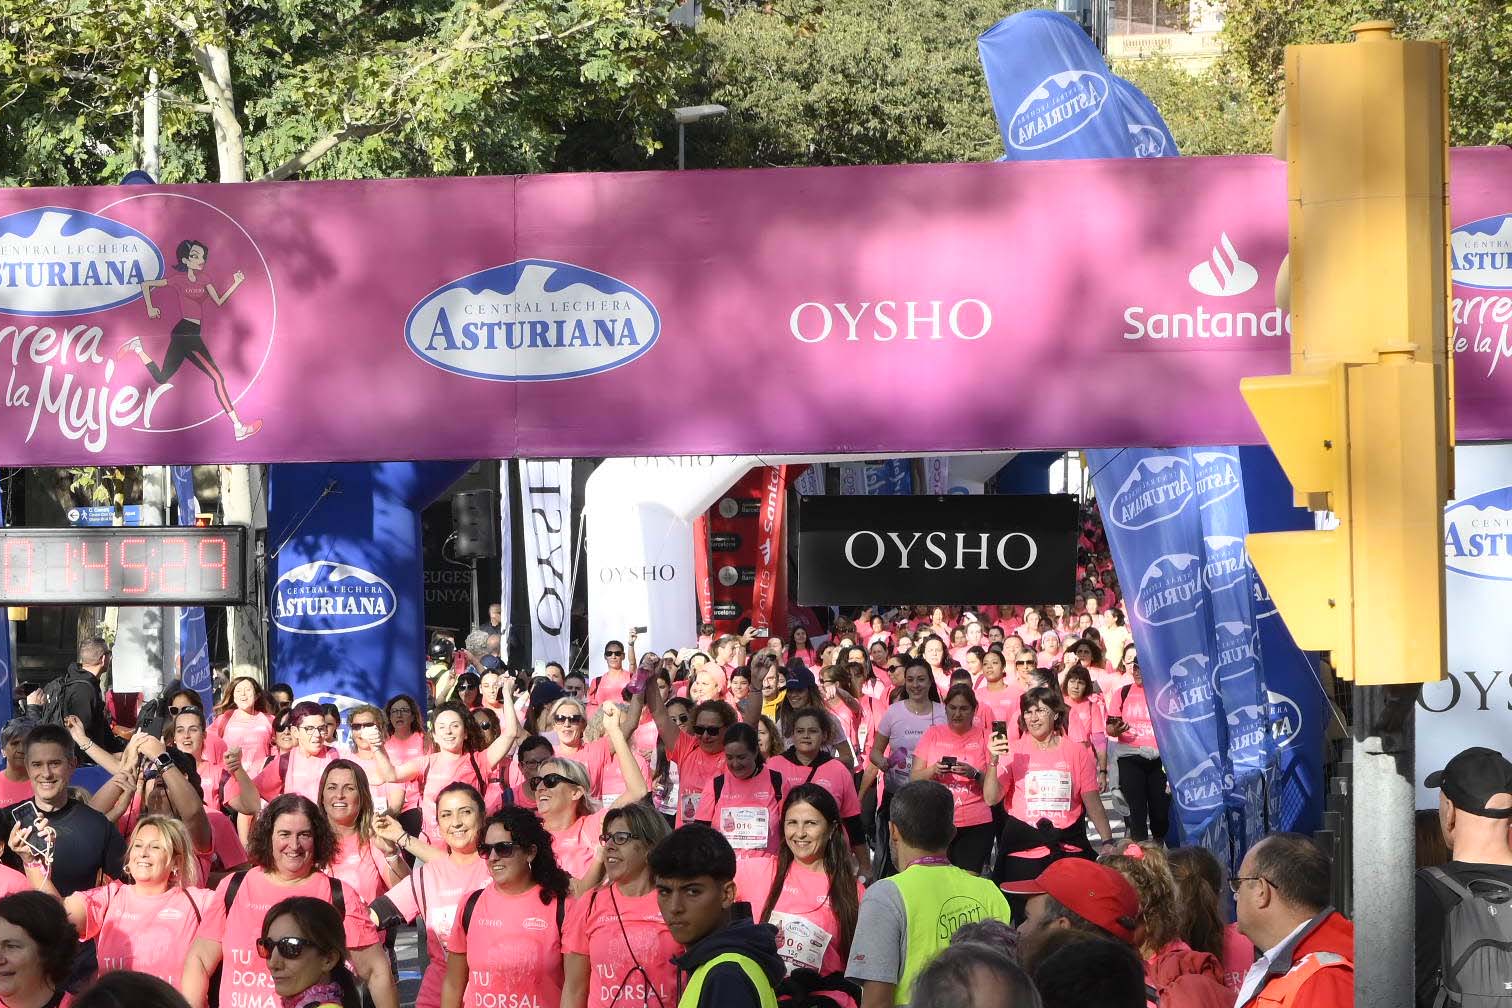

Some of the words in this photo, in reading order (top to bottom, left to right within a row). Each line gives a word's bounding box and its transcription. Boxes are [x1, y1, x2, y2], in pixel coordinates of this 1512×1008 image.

[66, 242, 140, 256] LECHERA
[465, 301, 546, 314] CENTRAL
[551, 299, 632, 312] LECHERA
[425, 306, 640, 351] ASTURIANA
[791, 298, 992, 343] OYSHO
[1123, 306, 1292, 340] Santand
[5, 368, 30, 407] la
[24, 358, 175, 453] Mujer
[845, 530, 1037, 571] OYSHO
[599, 563, 676, 586] OYSHO
[287, 586, 331, 595] CENTRAL
[334, 585, 383, 594] LECHERA
[275, 591, 387, 619] ASTURIANA
[940, 902, 983, 941] Sport
[232, 949, 252, 965] TU
[473, 971, 490, 986] TU
[598, 964, 615, 979] TU
[231, 991, 276, 1008] SUMA
[475, 992, 540, 1008] DORSAL
[601, 985, 668, 1001] DORSAL
